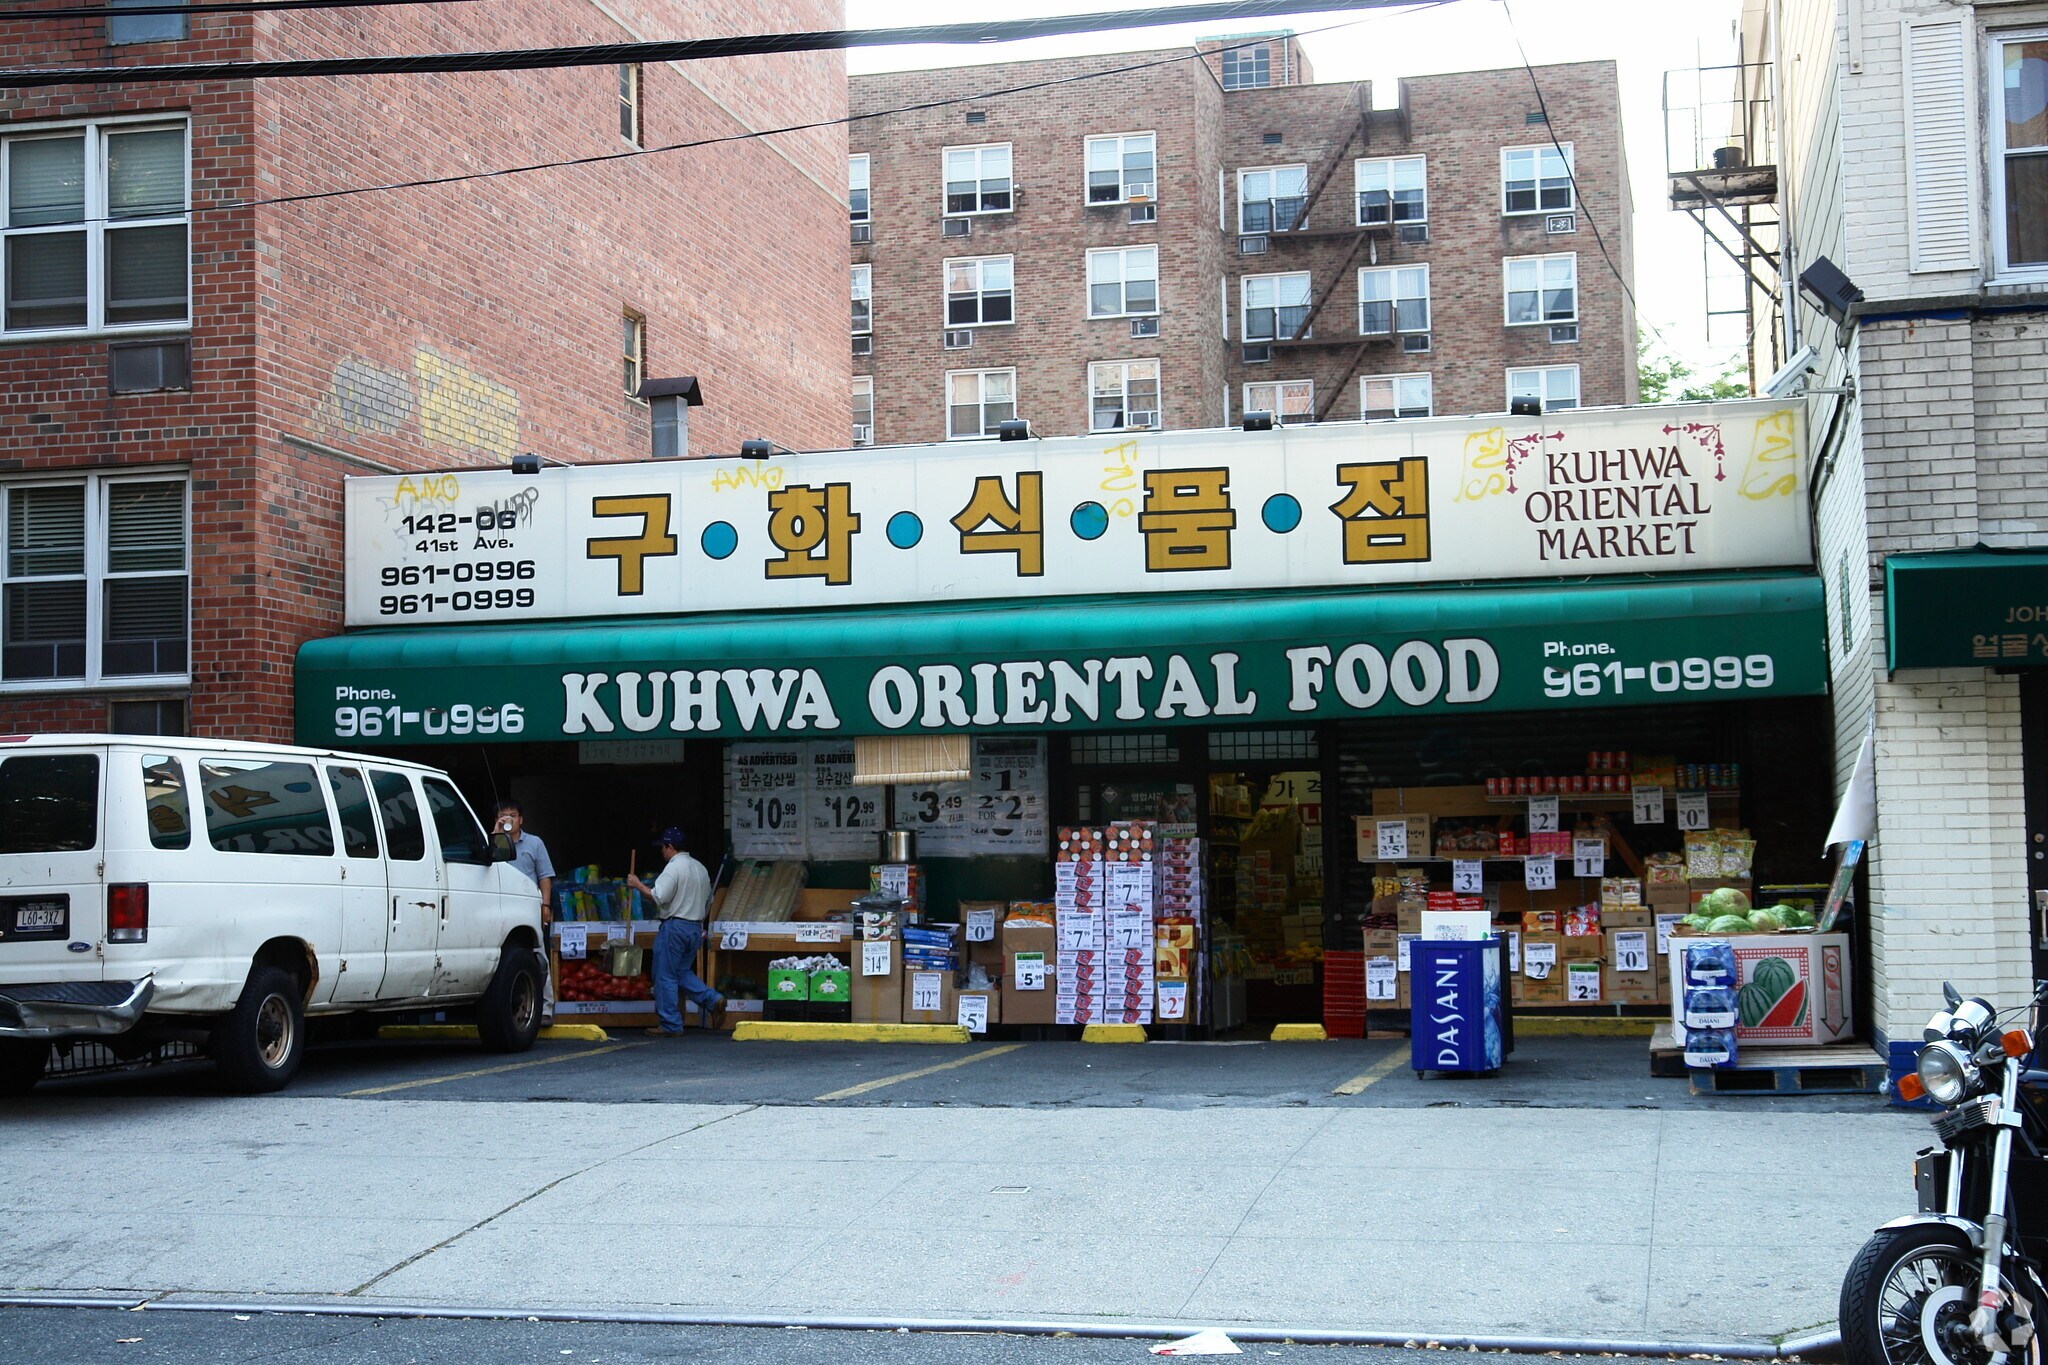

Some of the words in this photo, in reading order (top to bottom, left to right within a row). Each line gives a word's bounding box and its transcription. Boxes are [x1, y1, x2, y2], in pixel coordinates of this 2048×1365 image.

[1546, 446, 1691, 485] KUHWA
[1525, 483, 1711, 522] ORIENTAL
[402, 511, 516, 534] 142-06
[587, 493, 677, 596] 구
[765, 481, 861, 586] 화
[950, 471, 1044, 577] 식
[1138, 466, 1236, 573] 품
[1328, 456, 1431, 565] 점
[416, 539, 458, 553] 41st
[473, 537, 514, 550] Ave.
[1538, 520, 1698, 560] MARKET
[381, 560, 536, 587] 961-0996
[380, 588, 535, 615] 961-0999
[1543, 642, 1617, 657] Phone.
[561, 667, 841, 735] KUHWA
[868, 652, 1257, 729] ORIENTAL
[1285, 638, 1499, 712] FOOD
[1543, 654, 1774, 698] 961-0999
[336, 686, 396, 701] Phone.
[335, 704, 525, 738] 961-0996
[738, 756, 748, 765] AS
[750, 755, 797, 766] ADVERTISED
[814, 754, 825, 764] AS
[978, 811, 997, 821] FOR
[1430, 959, 1465, 1066] DASANI
